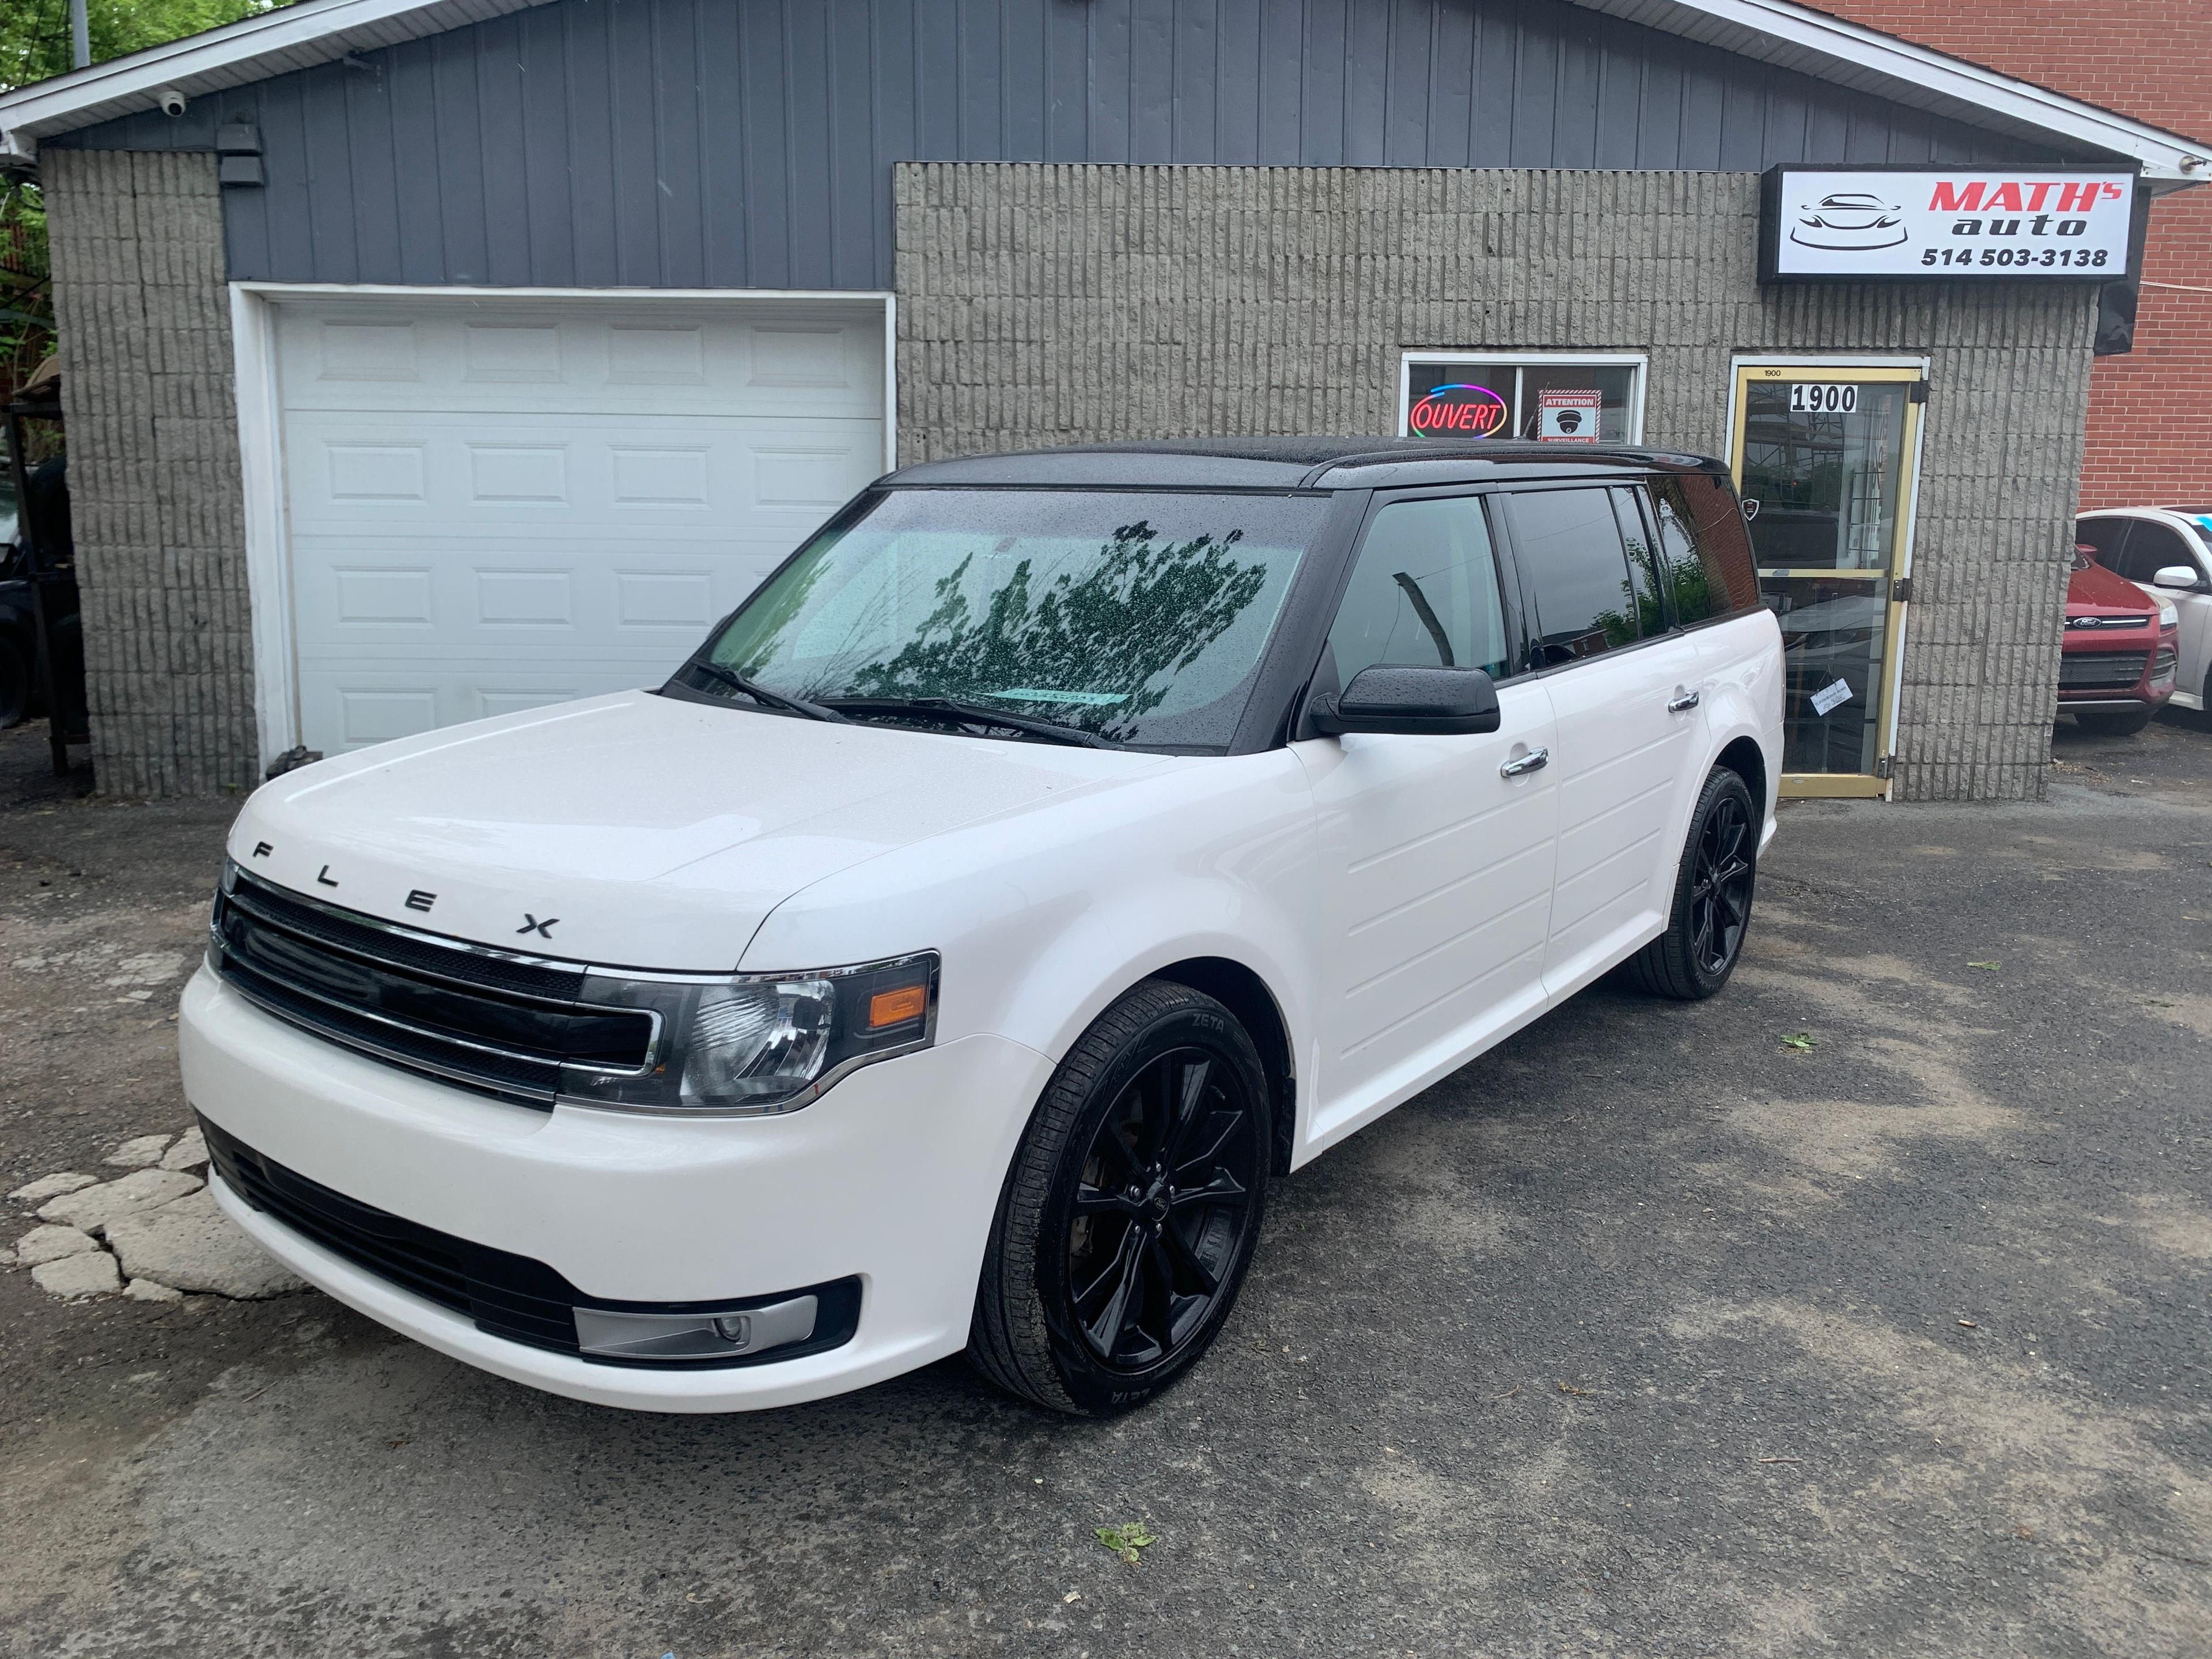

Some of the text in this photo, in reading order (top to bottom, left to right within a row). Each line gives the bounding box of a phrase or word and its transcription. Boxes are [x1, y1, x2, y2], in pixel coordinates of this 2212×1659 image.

[1952, 214, 2088, 236] auto
[1921, 248, 2108, 267] 514 503-3138
[1546, 398, 1594, 406] ATTENTION
[1792, 385, 1855, 411] 1900
[1416, 404, 1501, 429] OUVERT
[252, 841, 560, 939] FLEX
[1191, 1013, 1225, 1033] ZETA
